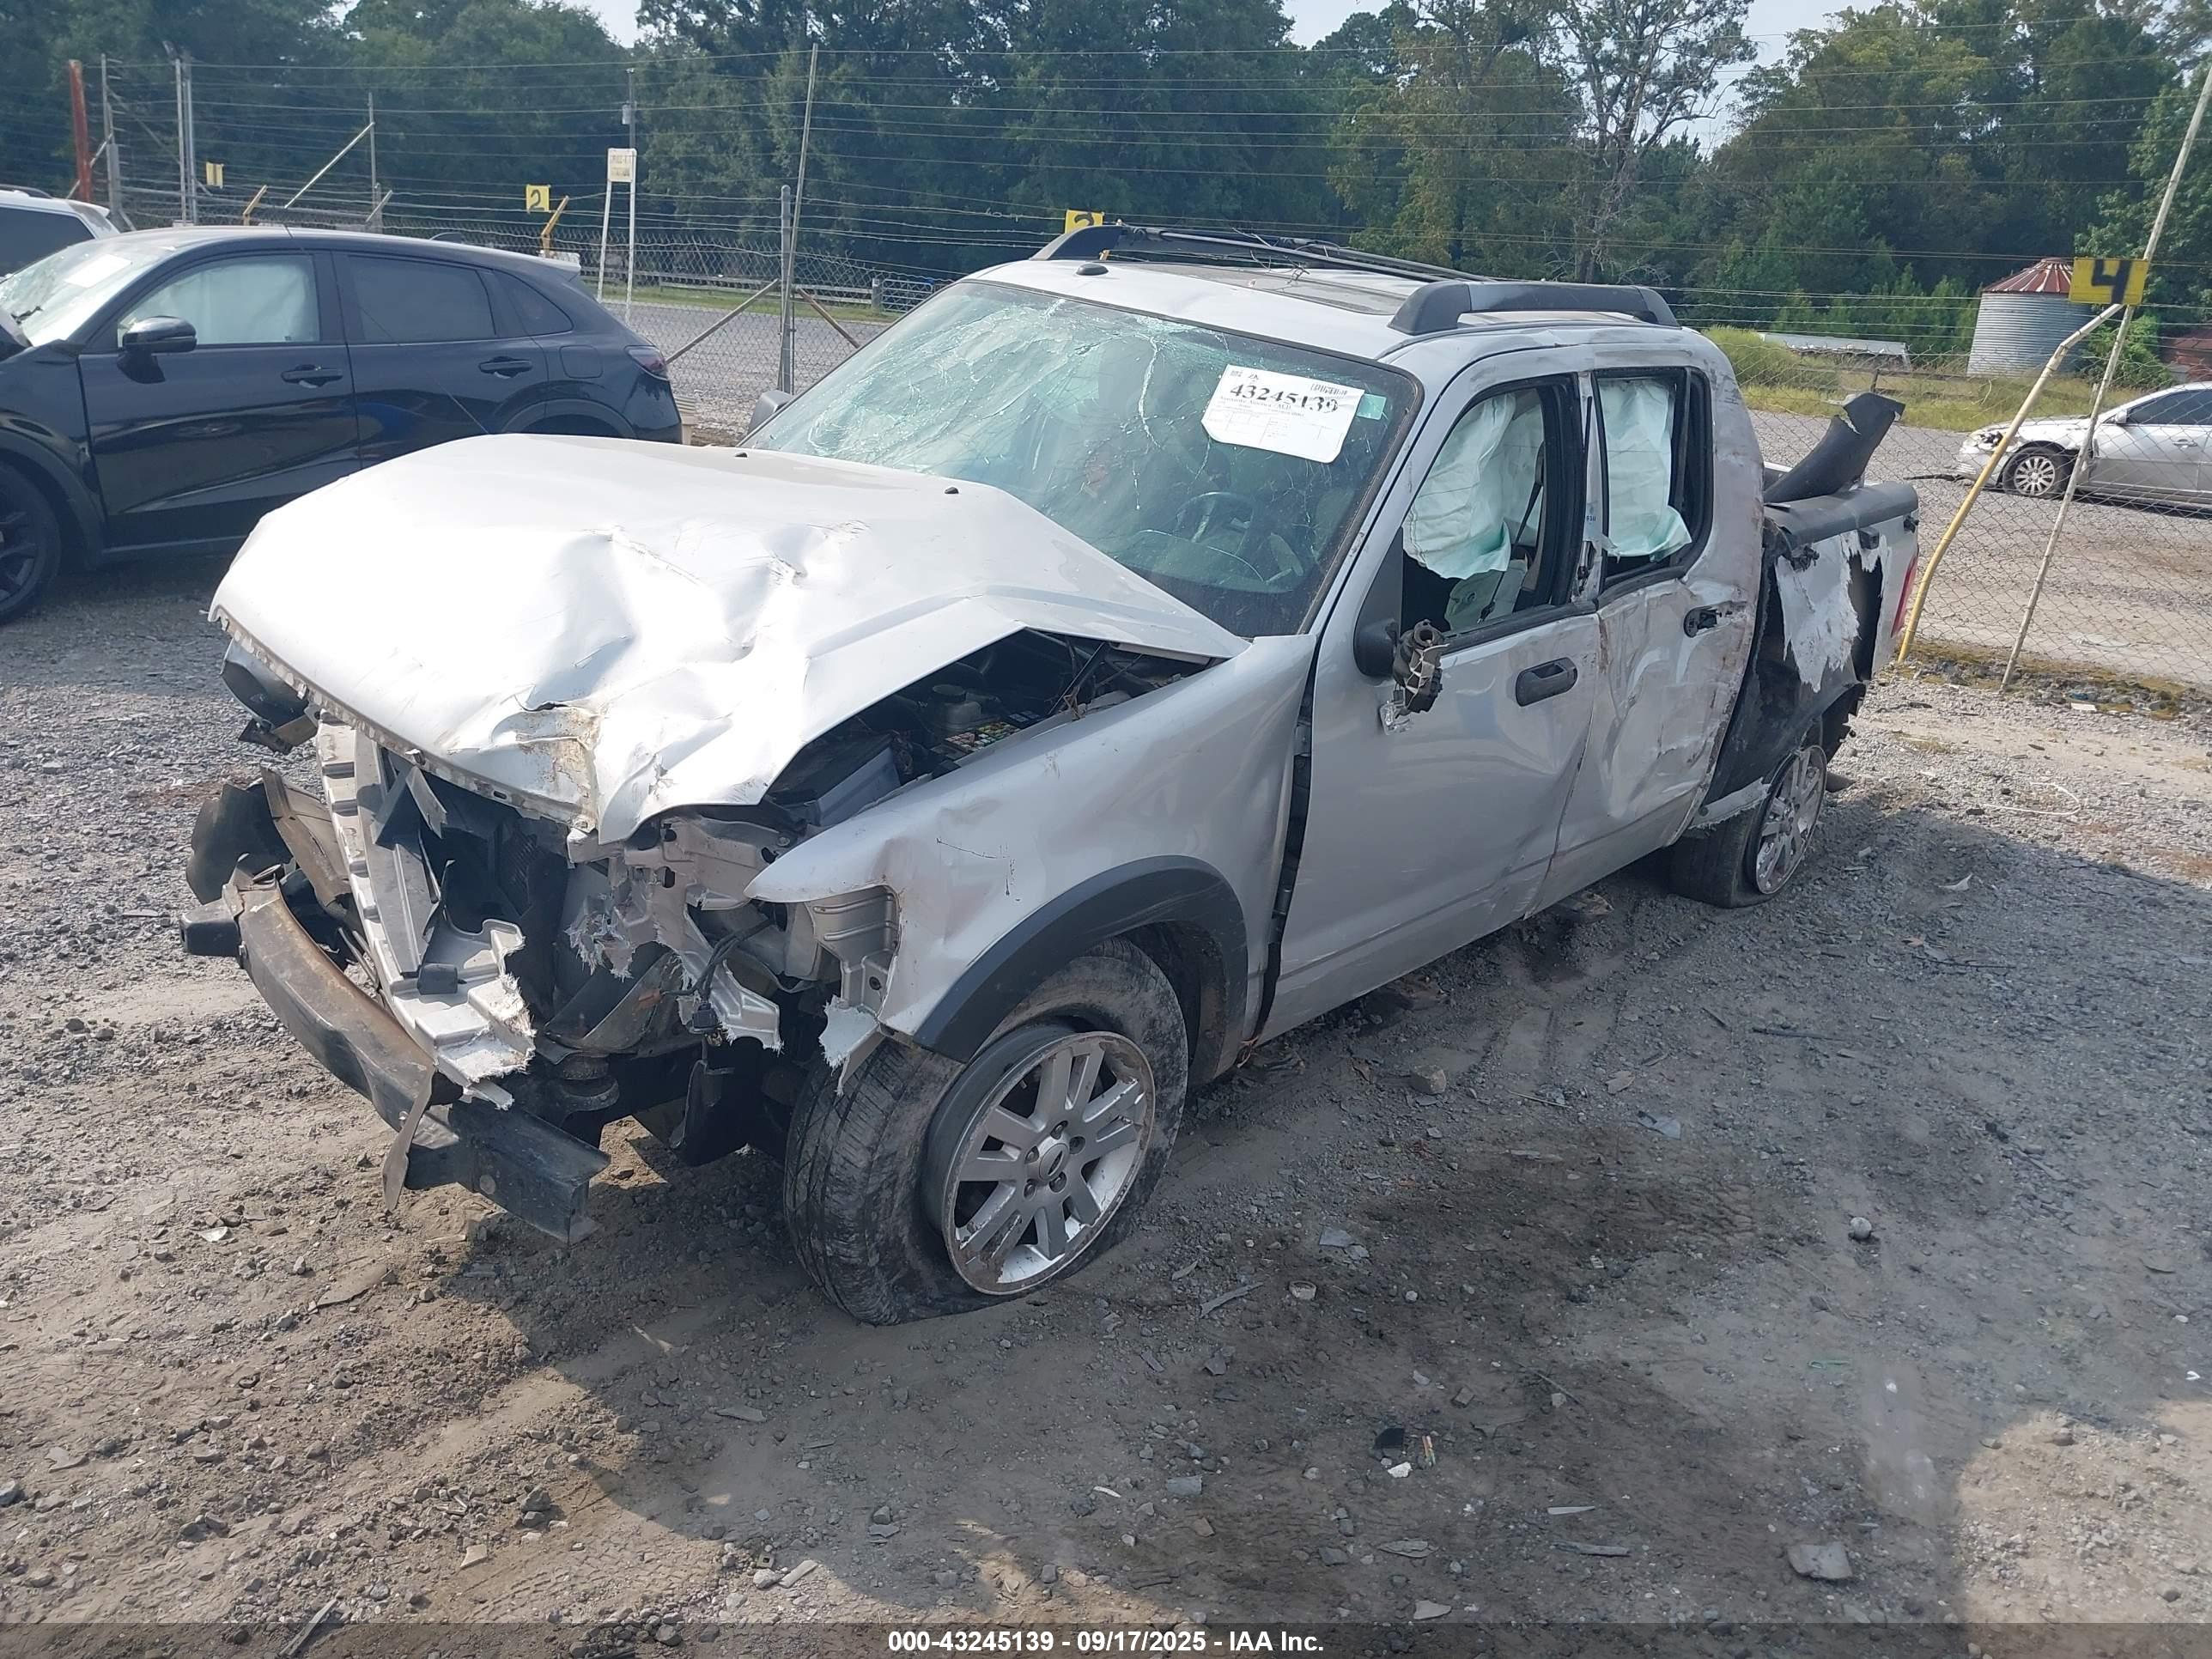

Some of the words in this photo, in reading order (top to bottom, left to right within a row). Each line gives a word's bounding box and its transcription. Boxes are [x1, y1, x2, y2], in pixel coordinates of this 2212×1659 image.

[529, 189, 545, 211] 2
[2091, 258, 2133, 304] 4
[1230, 384, 1339, 413] 43245139
